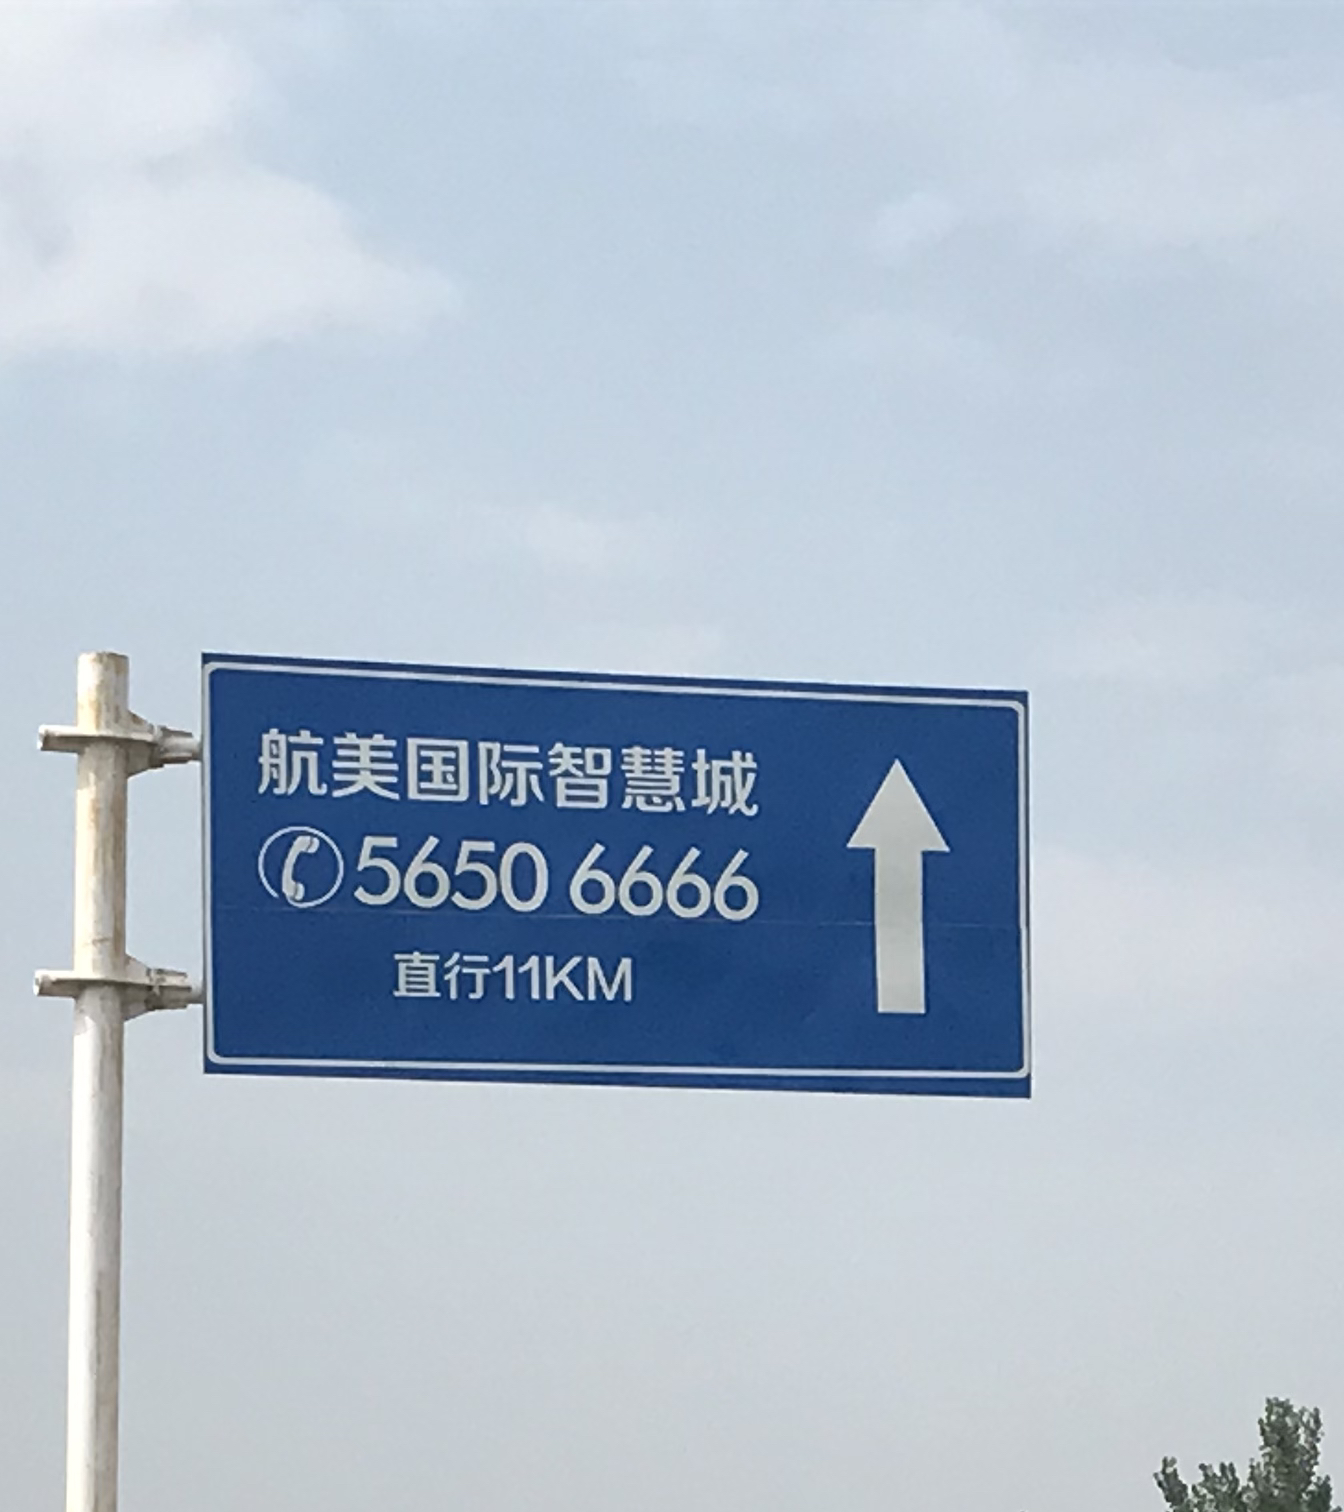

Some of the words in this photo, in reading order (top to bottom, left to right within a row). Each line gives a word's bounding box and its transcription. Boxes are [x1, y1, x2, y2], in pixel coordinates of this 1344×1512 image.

[258, 728, 758, 816] 航美国际智慧城
[354, 835, 548, 912] 5650
[569, 843, 759, 921] 6666
[393, 951, 632, 1001] 直行11KM
